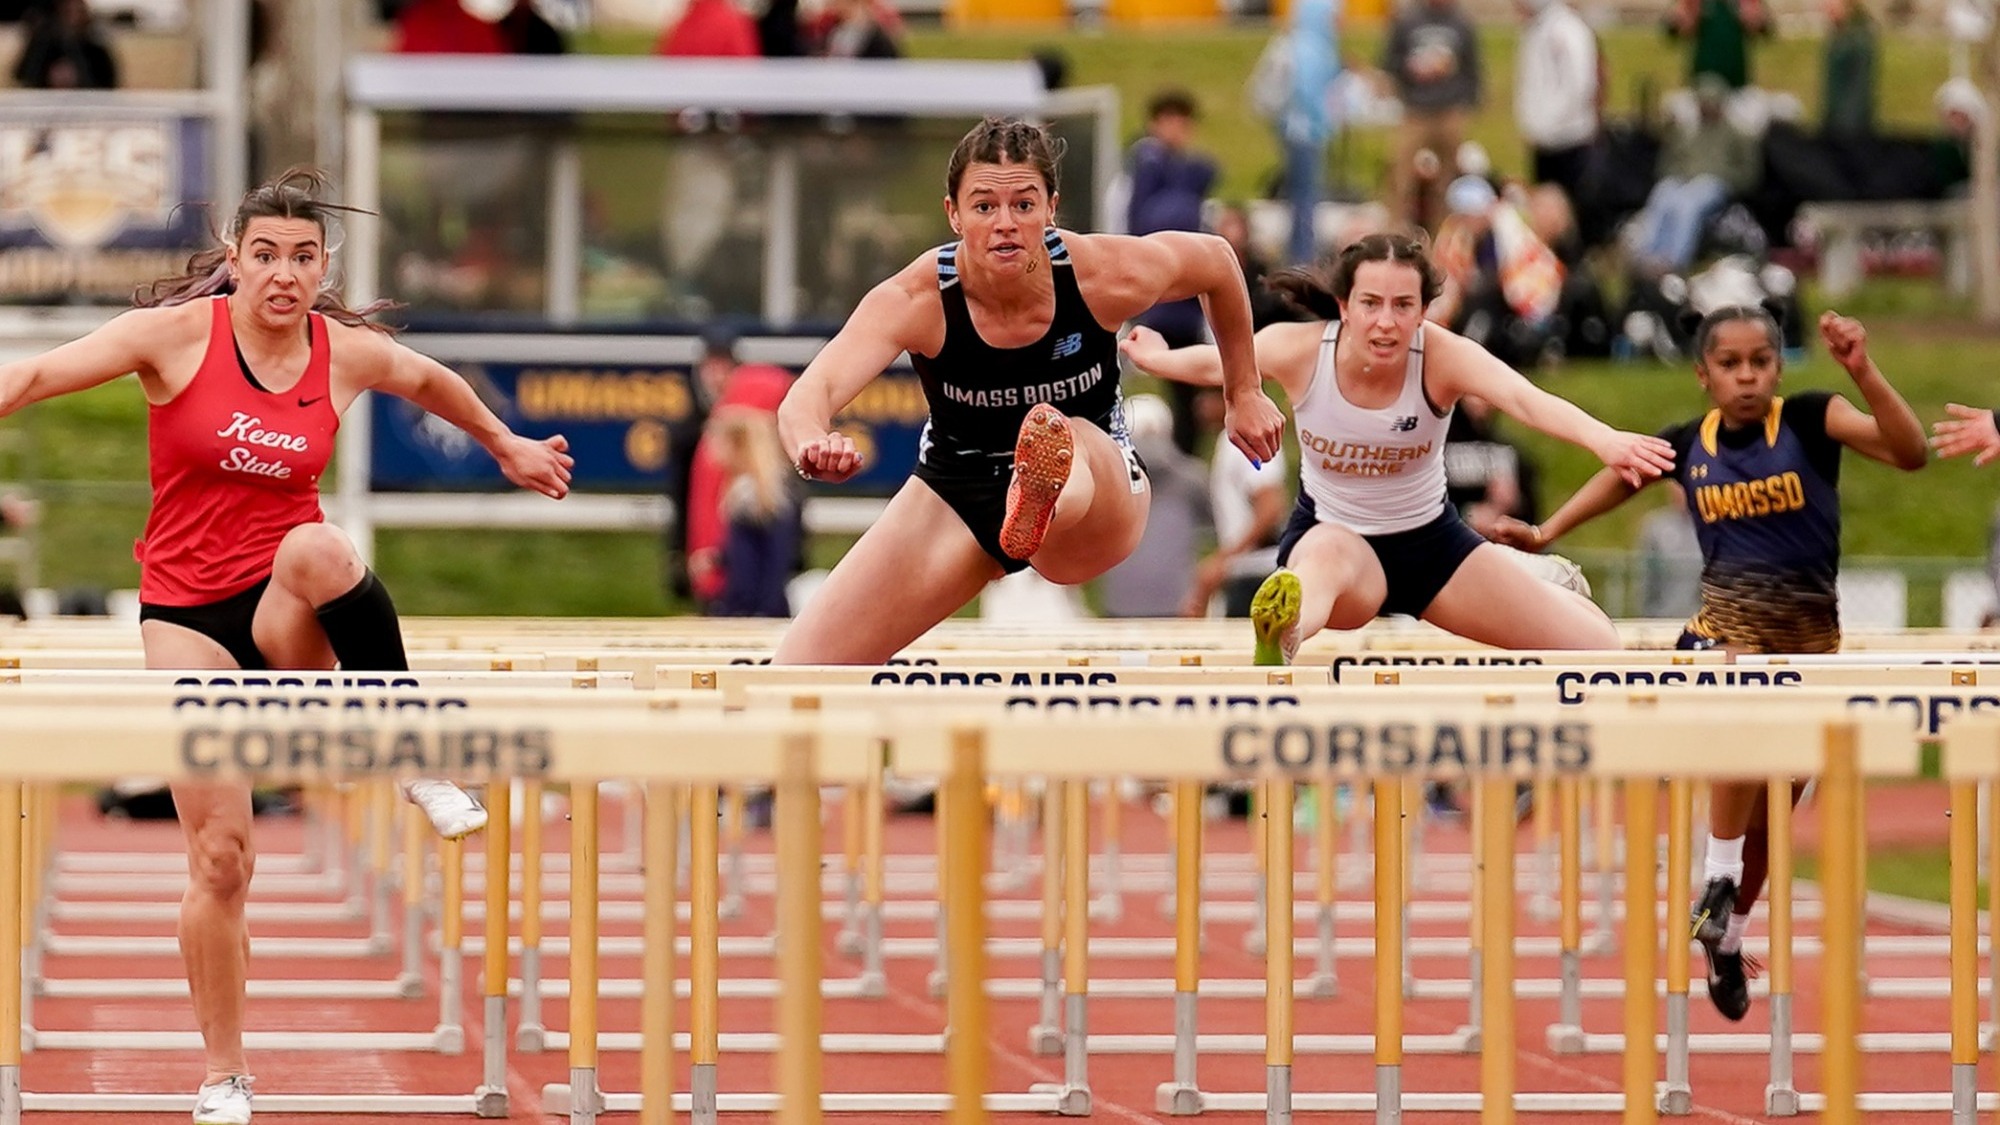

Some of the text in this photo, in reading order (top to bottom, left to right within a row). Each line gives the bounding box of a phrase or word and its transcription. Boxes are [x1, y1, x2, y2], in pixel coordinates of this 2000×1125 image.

[943, 381, 1018, 408] UMASS
[1023, 362, 1103, 405] BOSTON
[217, 411, 308, 452] Keene
[1300, 429, 1432, 461] SOUTHERN
[219, 446, 292, 479] State
[1695, 470, 1806, 525] UMASSD
[180, 726, 554, 772] CORSAIRS
[1220, 722, 1592, 771] CORSAIRS
